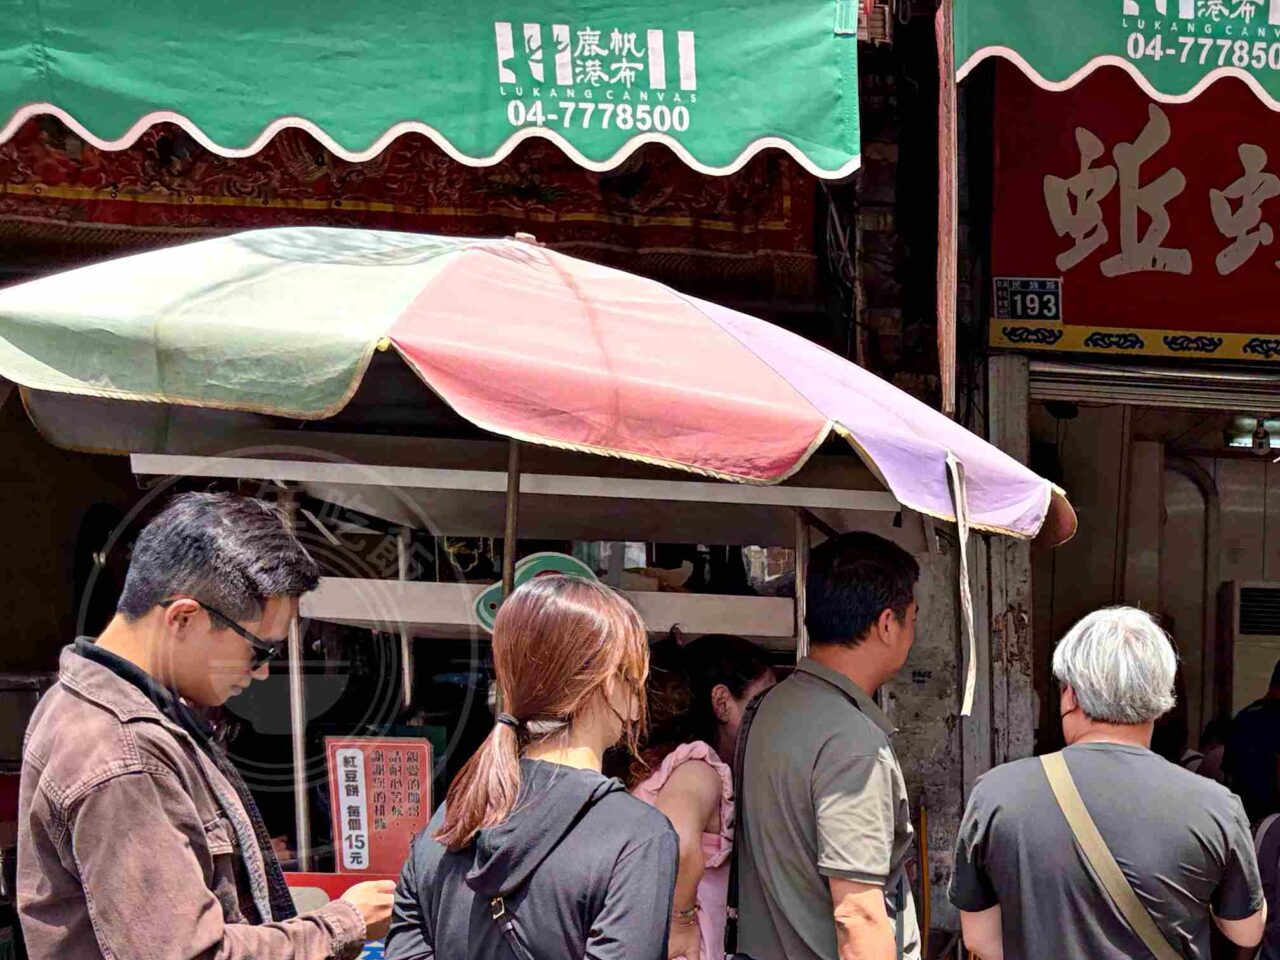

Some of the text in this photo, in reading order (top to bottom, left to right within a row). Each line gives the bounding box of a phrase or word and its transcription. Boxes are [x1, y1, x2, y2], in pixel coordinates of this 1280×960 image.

[1122, 19, 1212, 34] LUKANG
[500, 87, 697, 104] LUKANG CANVAS
[507, 100, 690, 132] 04-7778500
[1013, 294, 1057, 317] 193
